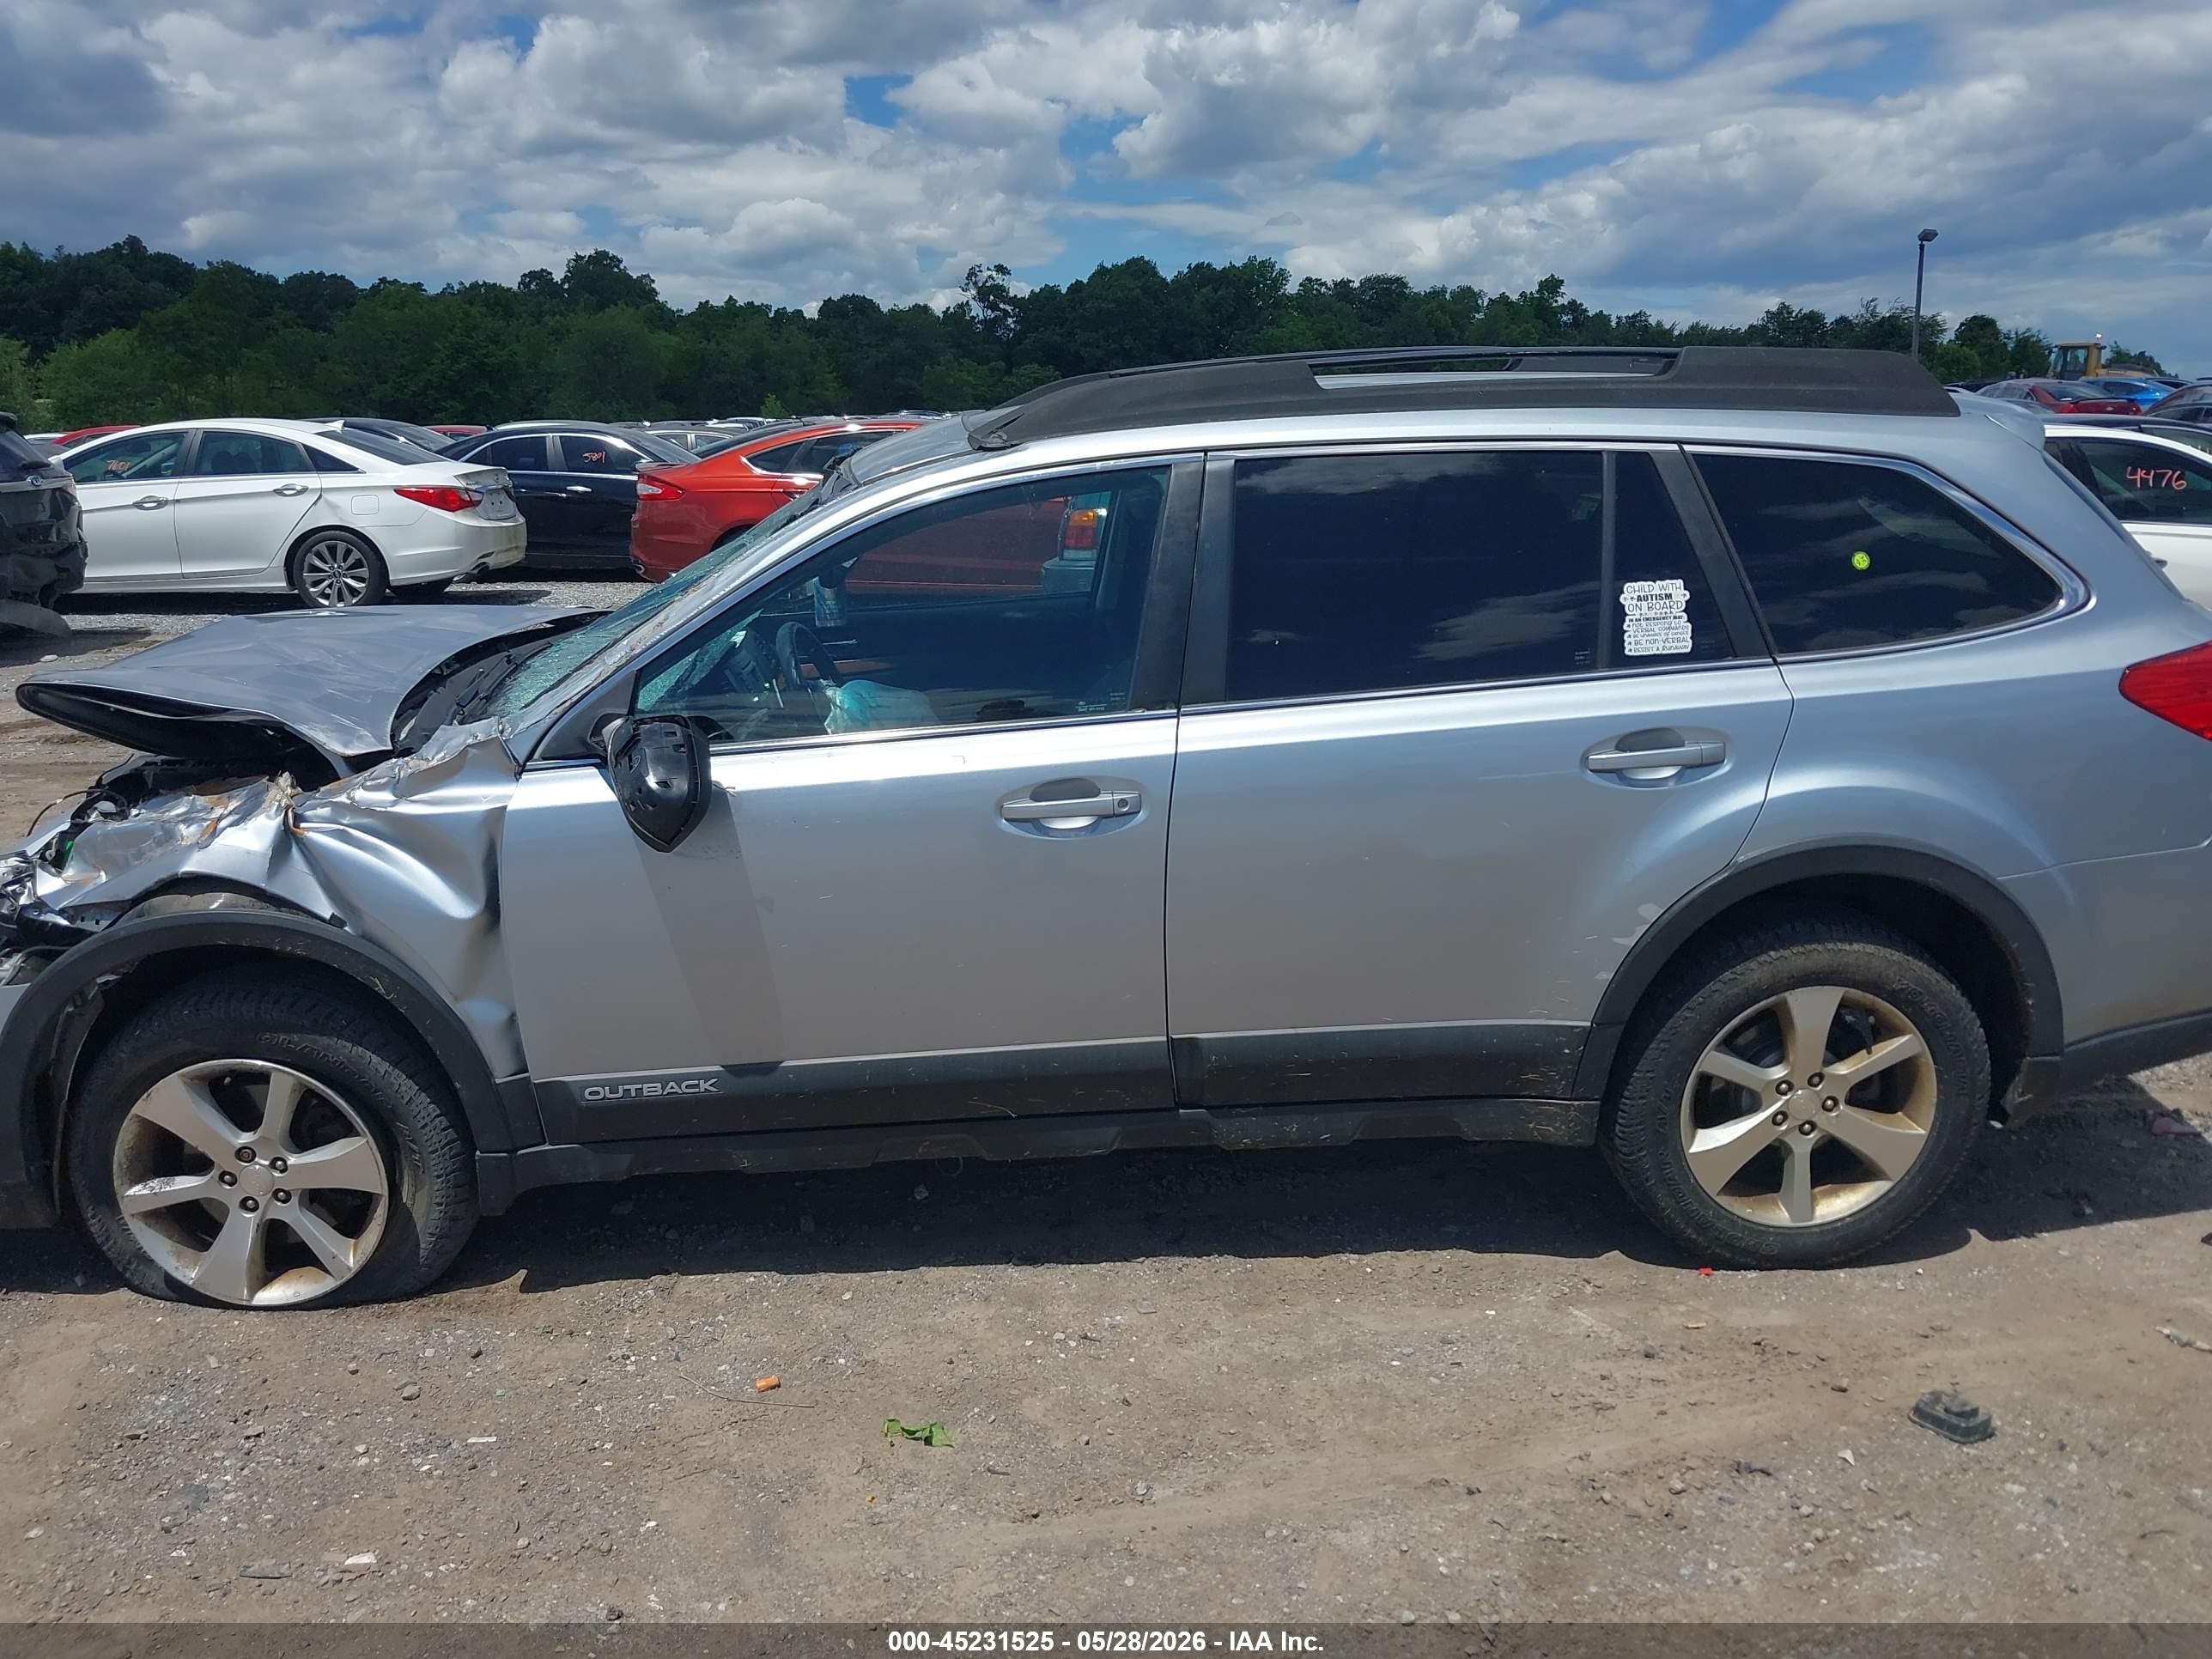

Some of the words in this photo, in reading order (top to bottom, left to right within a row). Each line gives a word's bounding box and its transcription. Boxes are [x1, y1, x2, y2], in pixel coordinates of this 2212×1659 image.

[2125, 466, 2187, 490] 4476
[1626, 584, 1655, 594] CHILD
[1657, 582, 1682, 592] WITH
[1637, 592, 1673, 602] AUTISM
[1628, 603, 1643, 612] ON
[1647, 600, 1683, 611] BOARD
[584, 1078, 719, 1101] OUTBACK
